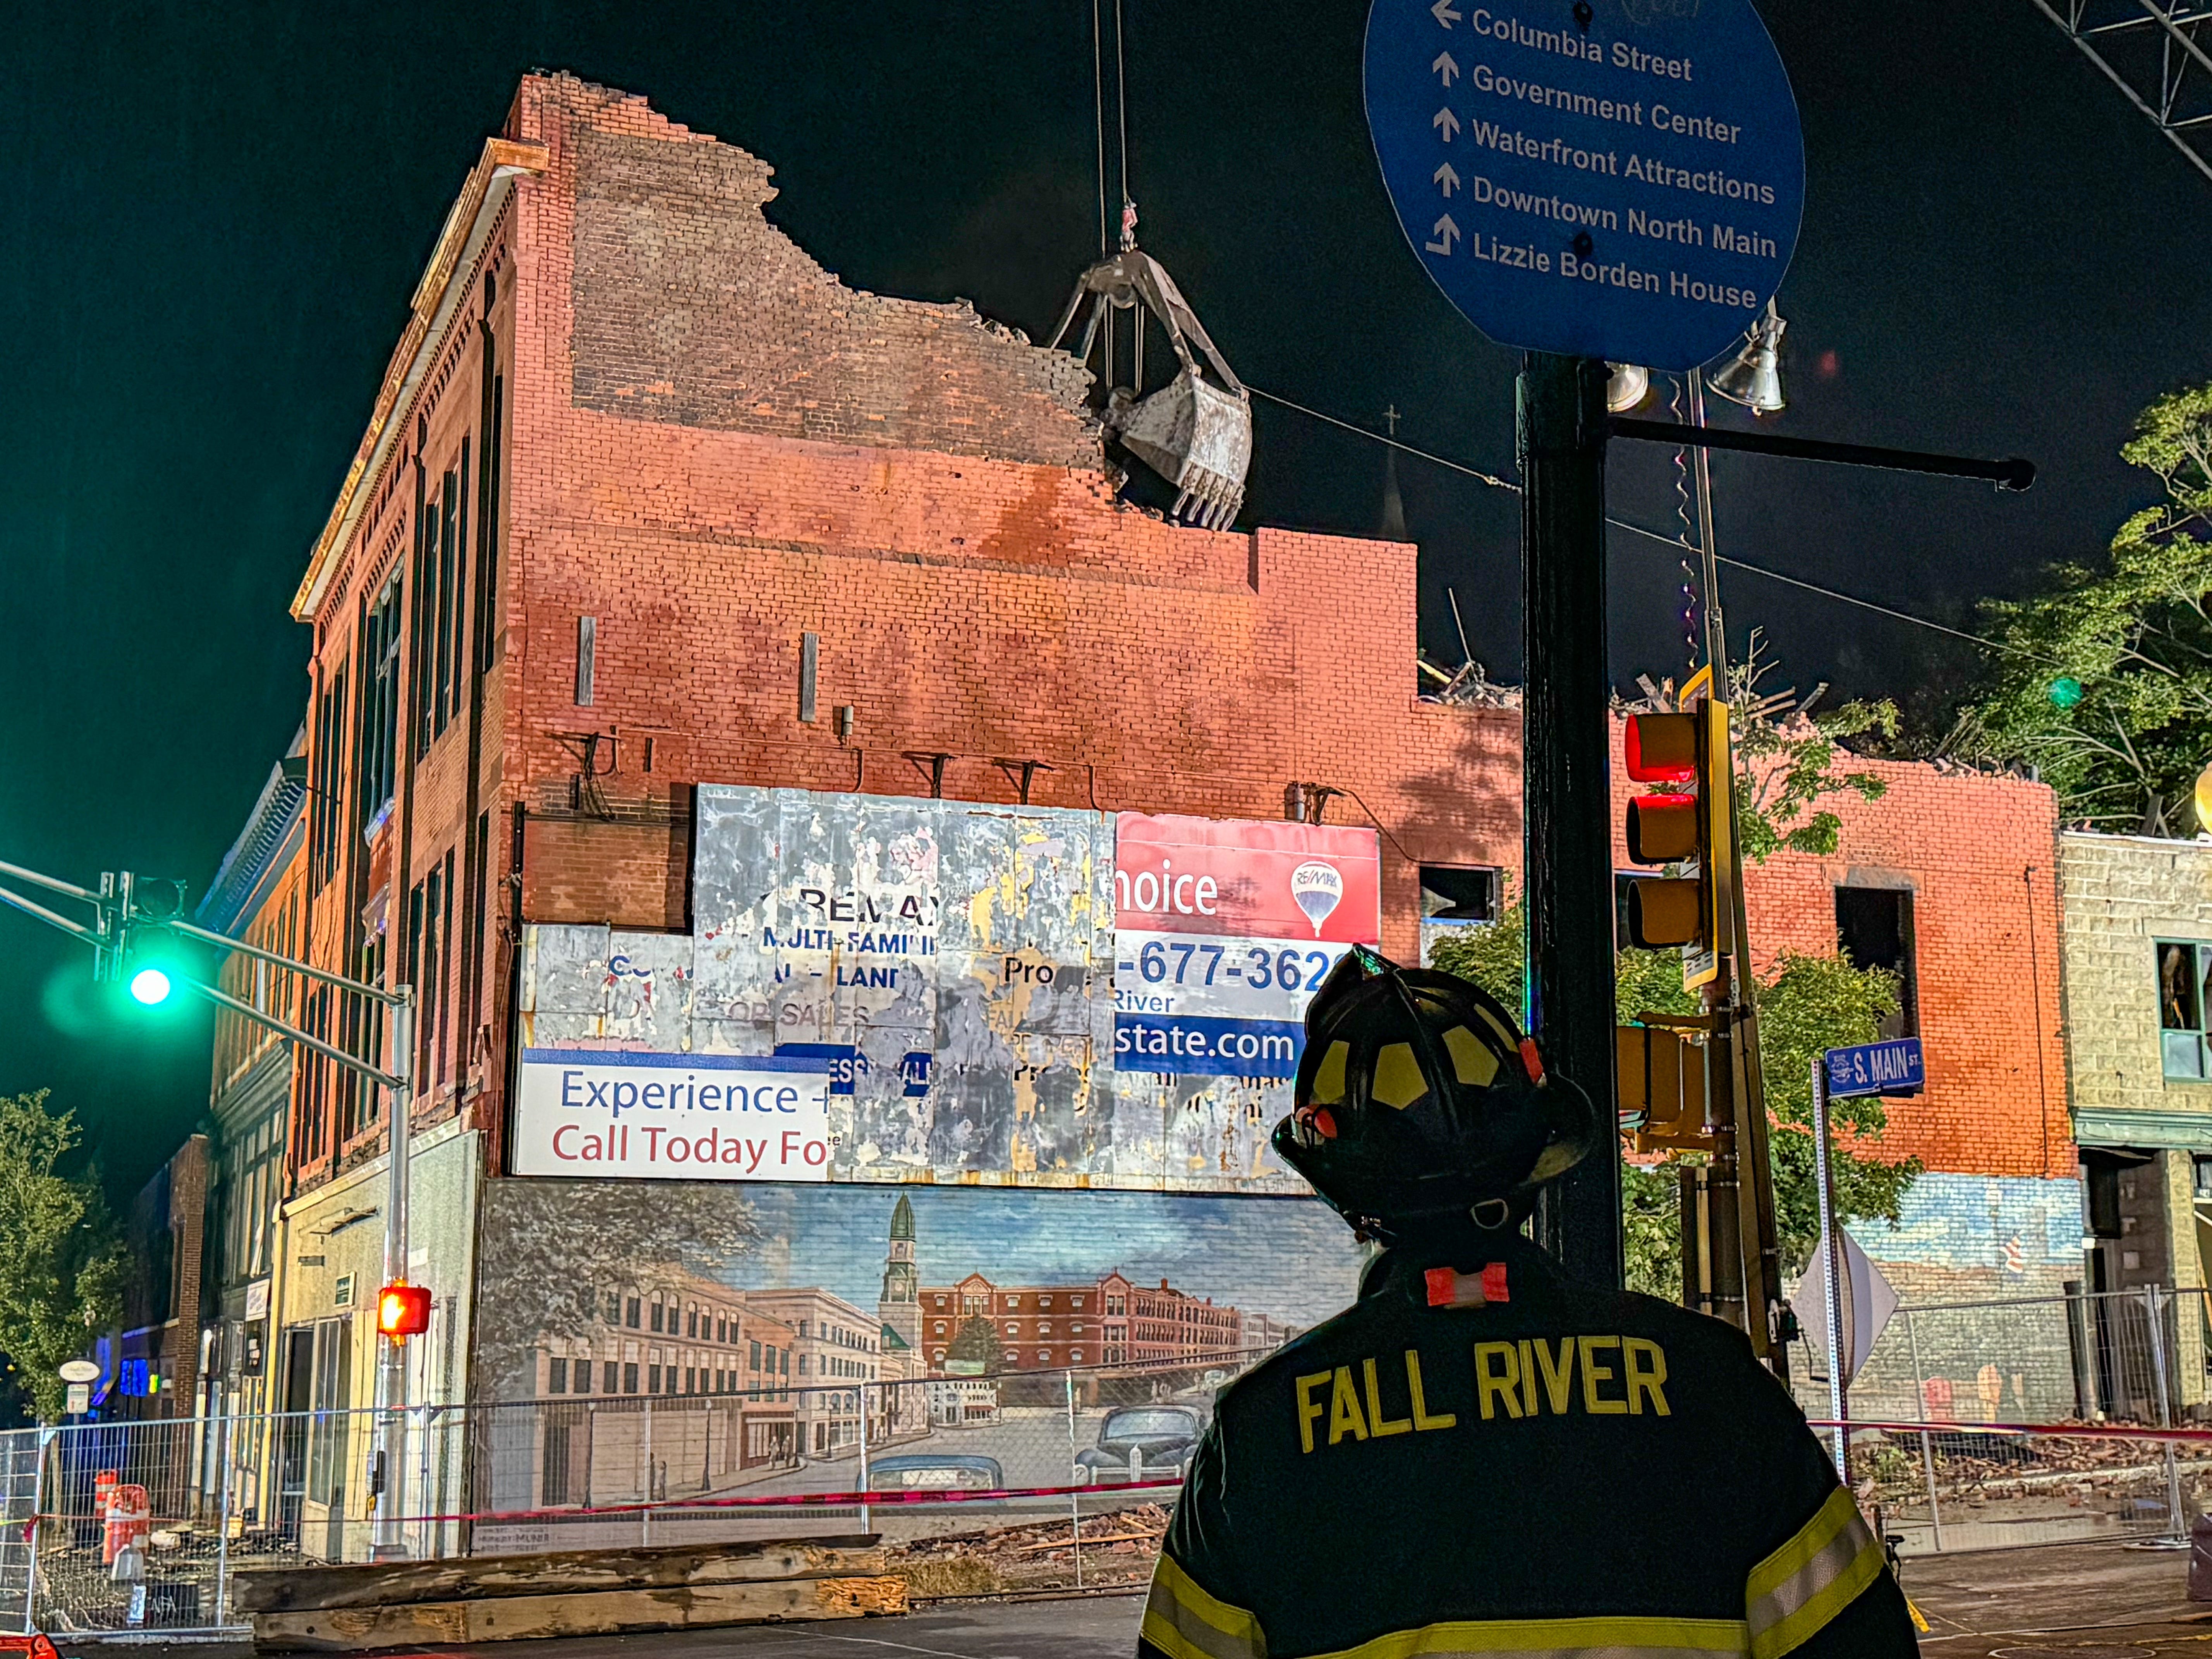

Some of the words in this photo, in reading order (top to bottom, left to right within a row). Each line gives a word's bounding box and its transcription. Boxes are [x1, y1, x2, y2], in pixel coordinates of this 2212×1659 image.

[1473, 9, 1602, 63] Columbia
[1611, 42, 1692, 81] Street
[1473, 65, 1642, 125] Government
[1651, 104, 1741, 144] Center
[1472, 118, 1617, 175] Waterfront
[1624, 154, 1775, 204] Attractions
[1474, 176, 1617, 231] Downtown
[1628, 208, 1703, 246] North
[1713, 224, 1776, 258] Main
[1474, 232, 1550, 273] Lizzie
[1560, 252, 1659, 293] Borden
[1670, 271, 1757, 309] House
[1118, 941, 1345, 992] -677-362
[1115, 1022, 1294, 1061] state.com
[1854, 1052, 1867, 1084] S.
[1870, 1046, 1908, 1082] MAIN
[562, 1070, 799, 1118] Experience
[553, 1125, 628, 1161] Call
[641, 1127, 768, 1174] Today
[781, 1131, 826, 1166] Fo
[1296, 1350, 1456, 1454] FALL
[1474, 1335, 1671, 1420] RIVER
